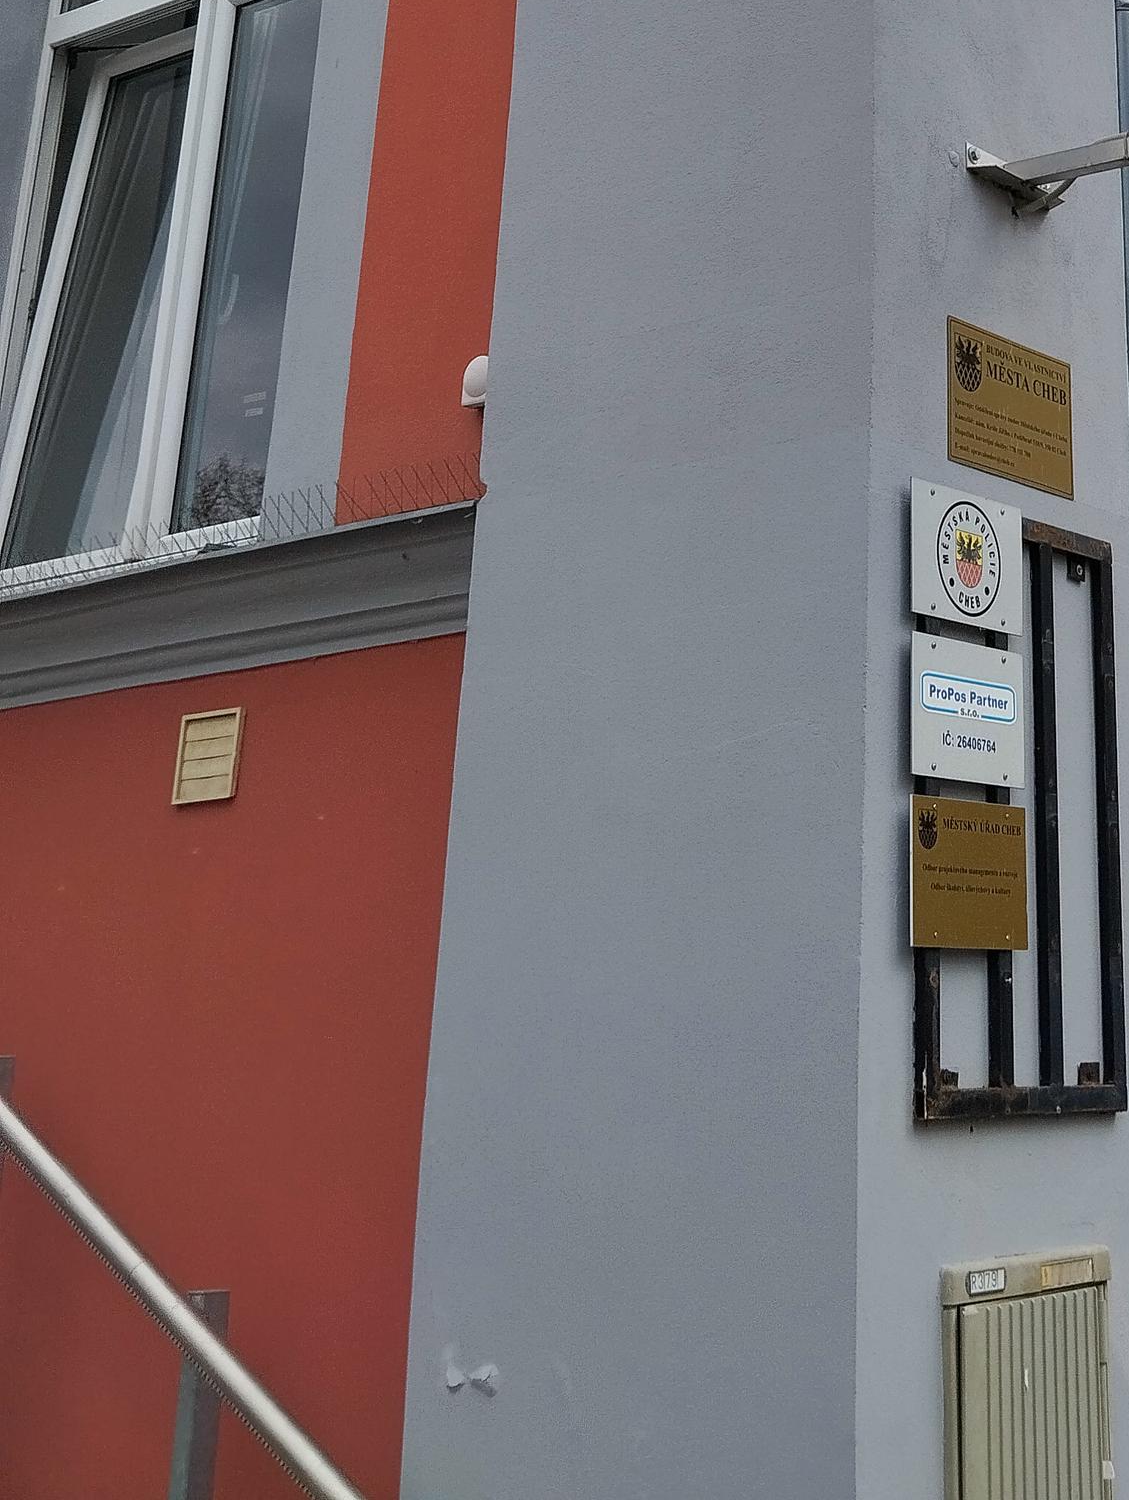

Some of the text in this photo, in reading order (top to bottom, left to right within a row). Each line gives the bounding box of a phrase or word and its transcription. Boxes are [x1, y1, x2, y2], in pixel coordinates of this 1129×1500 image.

[986, 344, 1014, 363] BUDOVA
[986, 360, 1067, 406] MĚSTA CHEB
[941, 508, 996, 578] MĚSTSKÁ POLICIE
[958, 591, 981, 608] CHEB
[929, 683, 1008, 711] ProPos Partner
[960, 707, 980, 718] s.r.o.
[957, 735, 996, 753] 26406764
[943, 815, 1022, 837] MĚSTSKÝ ÚŘAD CHEB
[971, 1271, 998, 1290] R379
